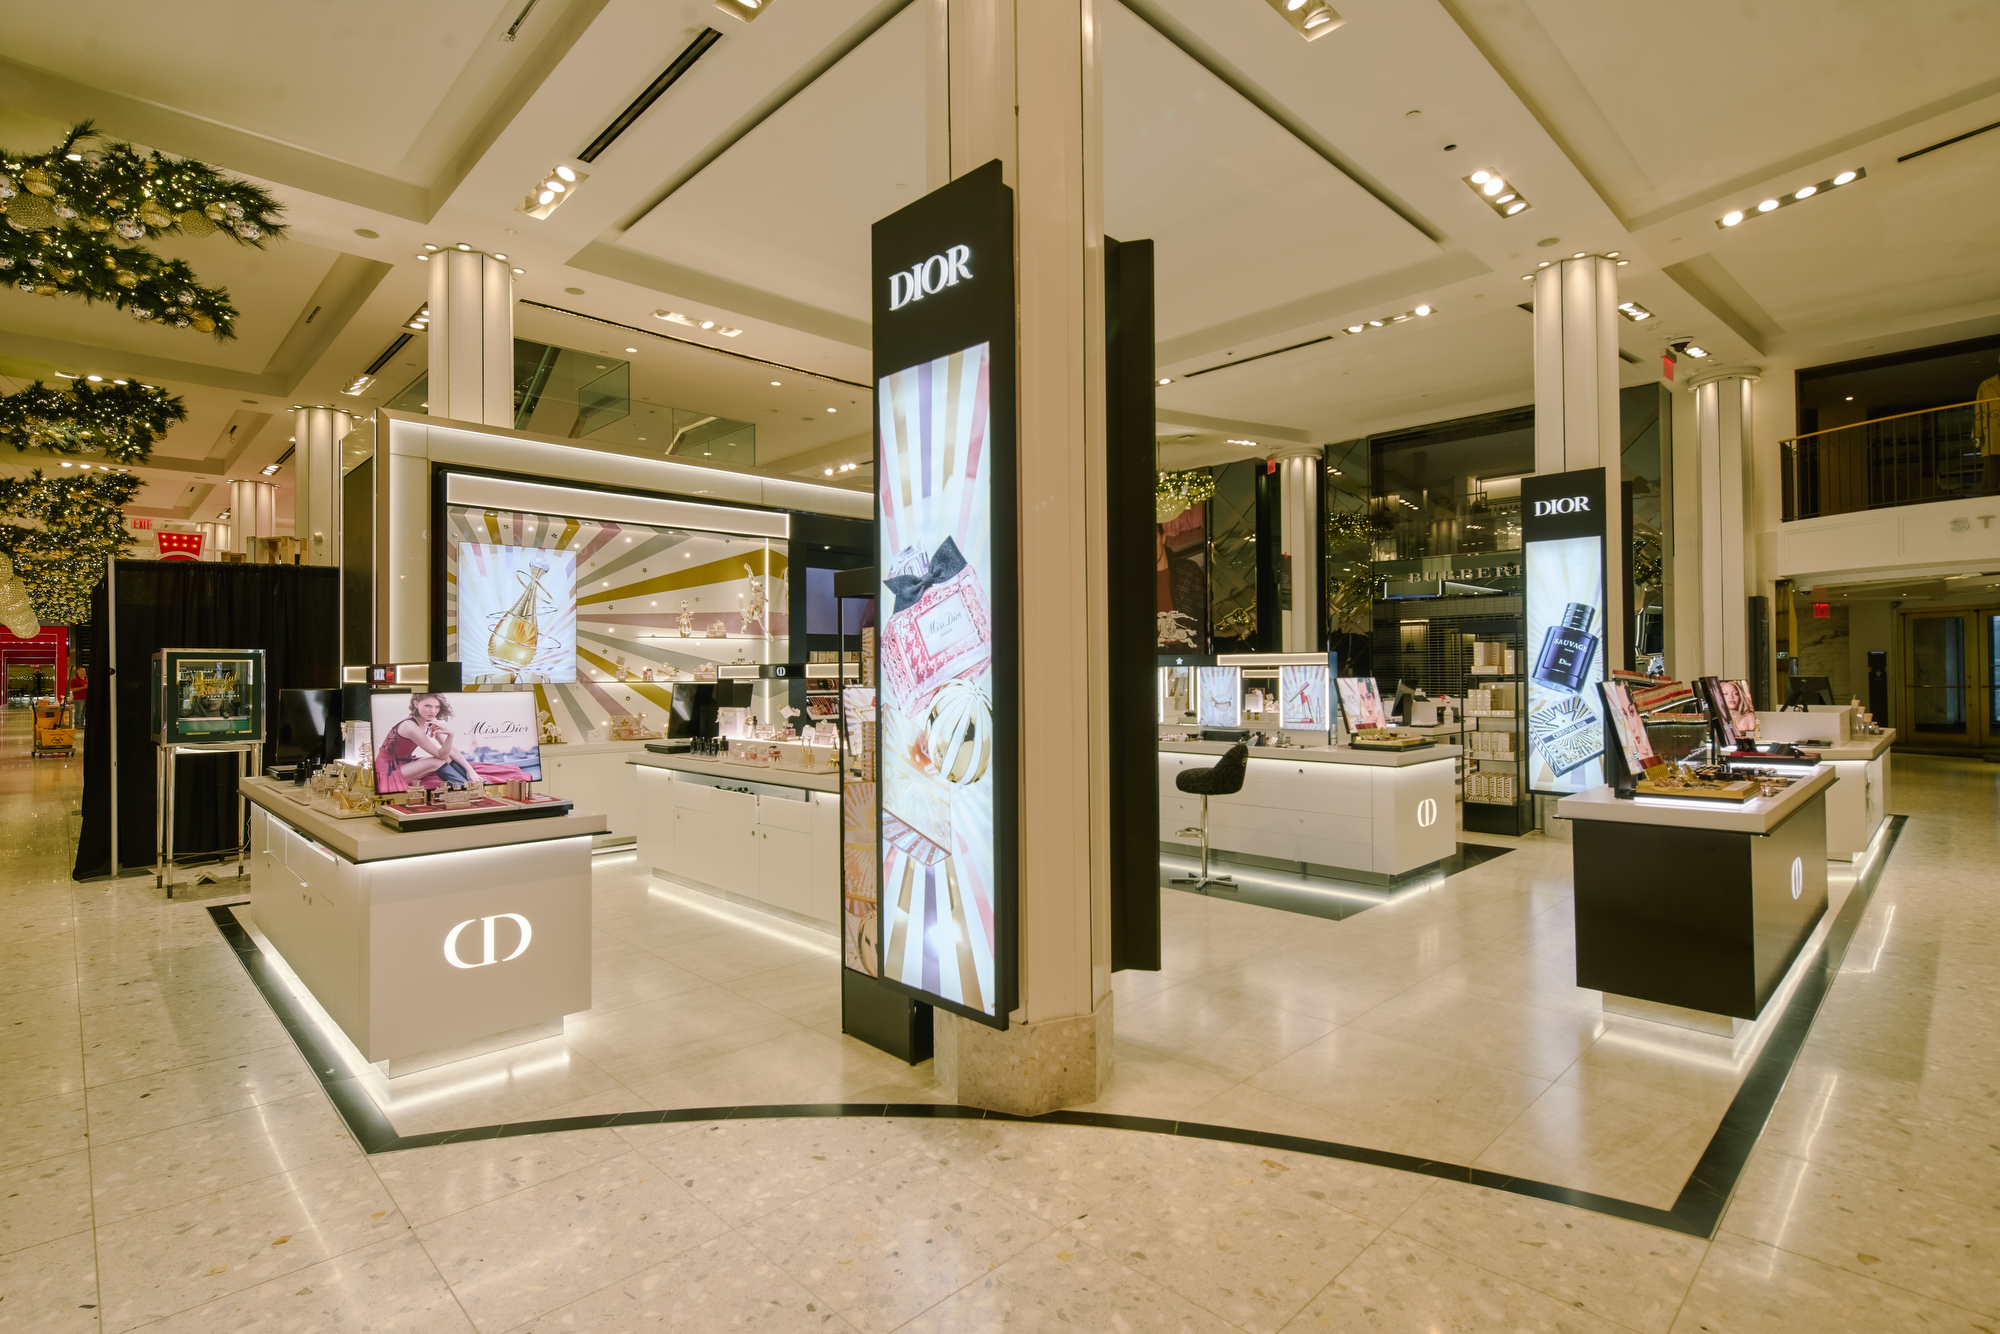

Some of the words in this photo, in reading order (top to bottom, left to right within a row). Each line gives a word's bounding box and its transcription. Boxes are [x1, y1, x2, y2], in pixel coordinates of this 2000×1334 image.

[888, 244, 974, 311] DIOR
[1533, 496, 1591, 517] DIOR
[133, 518, 151, 530] EXIT
[1815, 603, 1828, 617] EXIT
[925, 619, 945, 639] Miss
[944, 611, 962, 627] Dior
[1553, 638, 1588, 653] SAUVAGE
[463, 721, 499, 736] Miss
[501, 720, 529, 734] Dior
